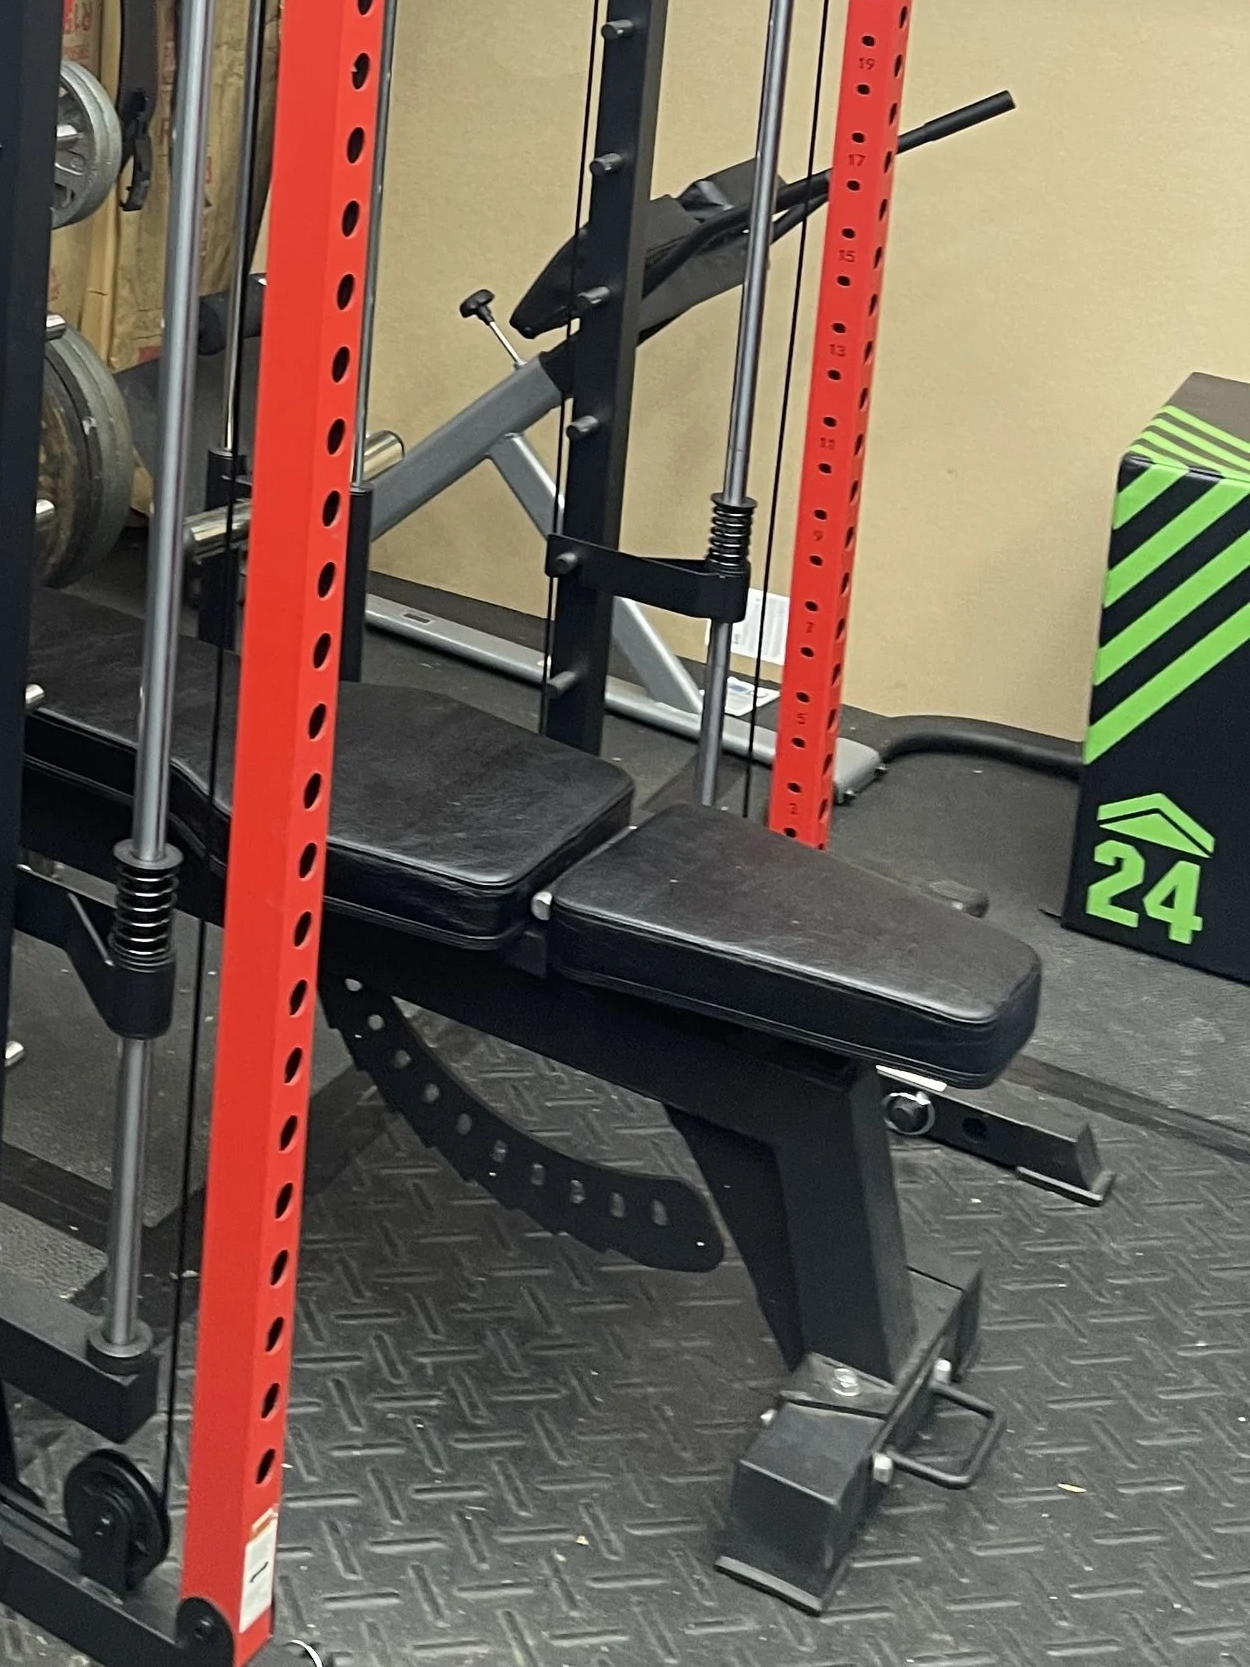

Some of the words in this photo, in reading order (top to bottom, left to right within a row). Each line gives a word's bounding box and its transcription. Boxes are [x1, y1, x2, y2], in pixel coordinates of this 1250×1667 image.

[859, 57, 875, 71] 19
[848, 153, 866, 168] 17
[839, 249, 855, 264] 15
[1085, 839, 1204, 945] 24
